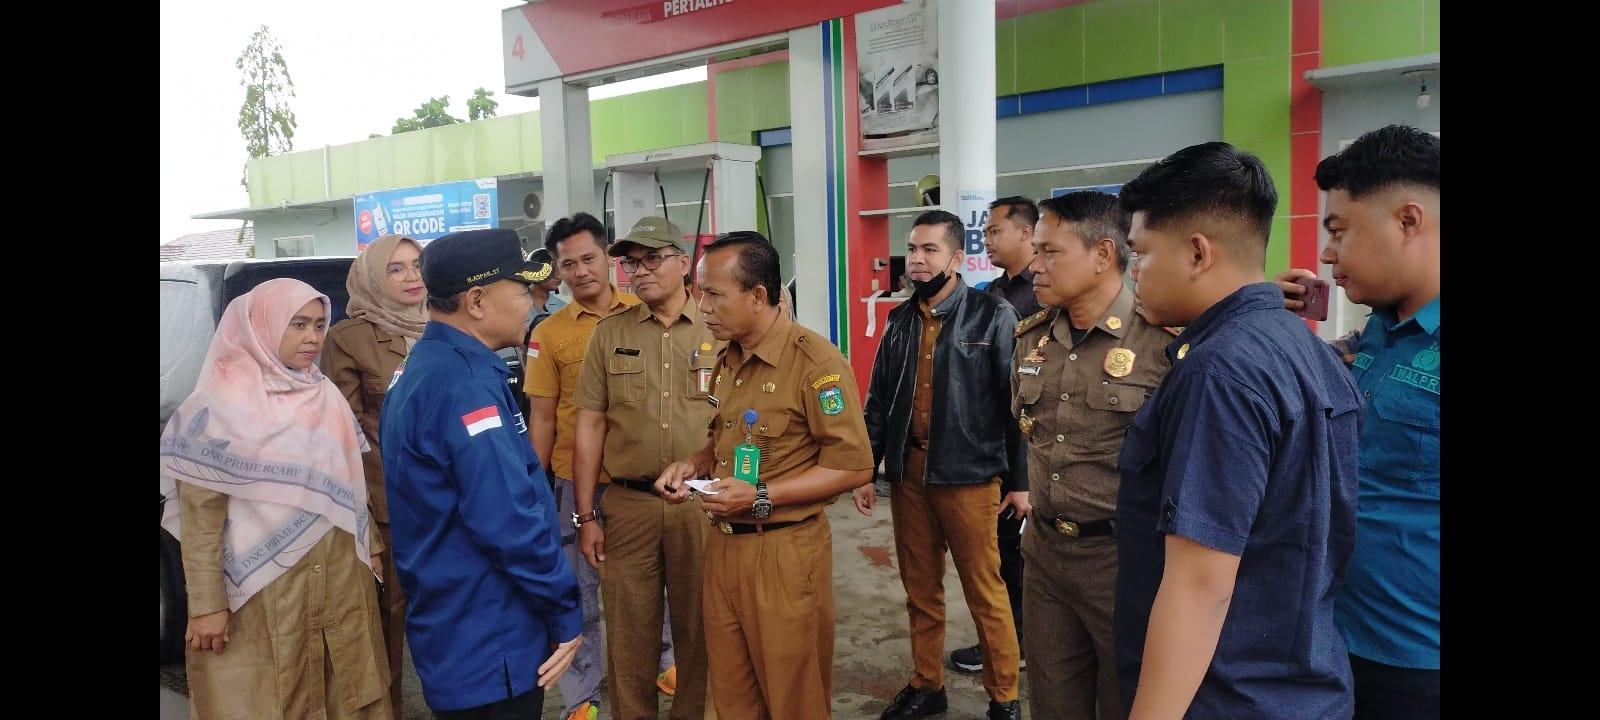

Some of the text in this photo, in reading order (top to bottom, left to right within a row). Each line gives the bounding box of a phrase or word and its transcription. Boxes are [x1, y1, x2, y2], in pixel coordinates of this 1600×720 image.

[511, 35, 525, 60] 4
[394, 220, 411, 236] QR
[412, 216, 446, 235] CODE
[967, 210, 989, 227] JA
[1397, 369, 1438, 391] WALPR
[200, 447, 302, 478] DNC PRIME SCARF
[264, 525, 296, 552] PRIME
